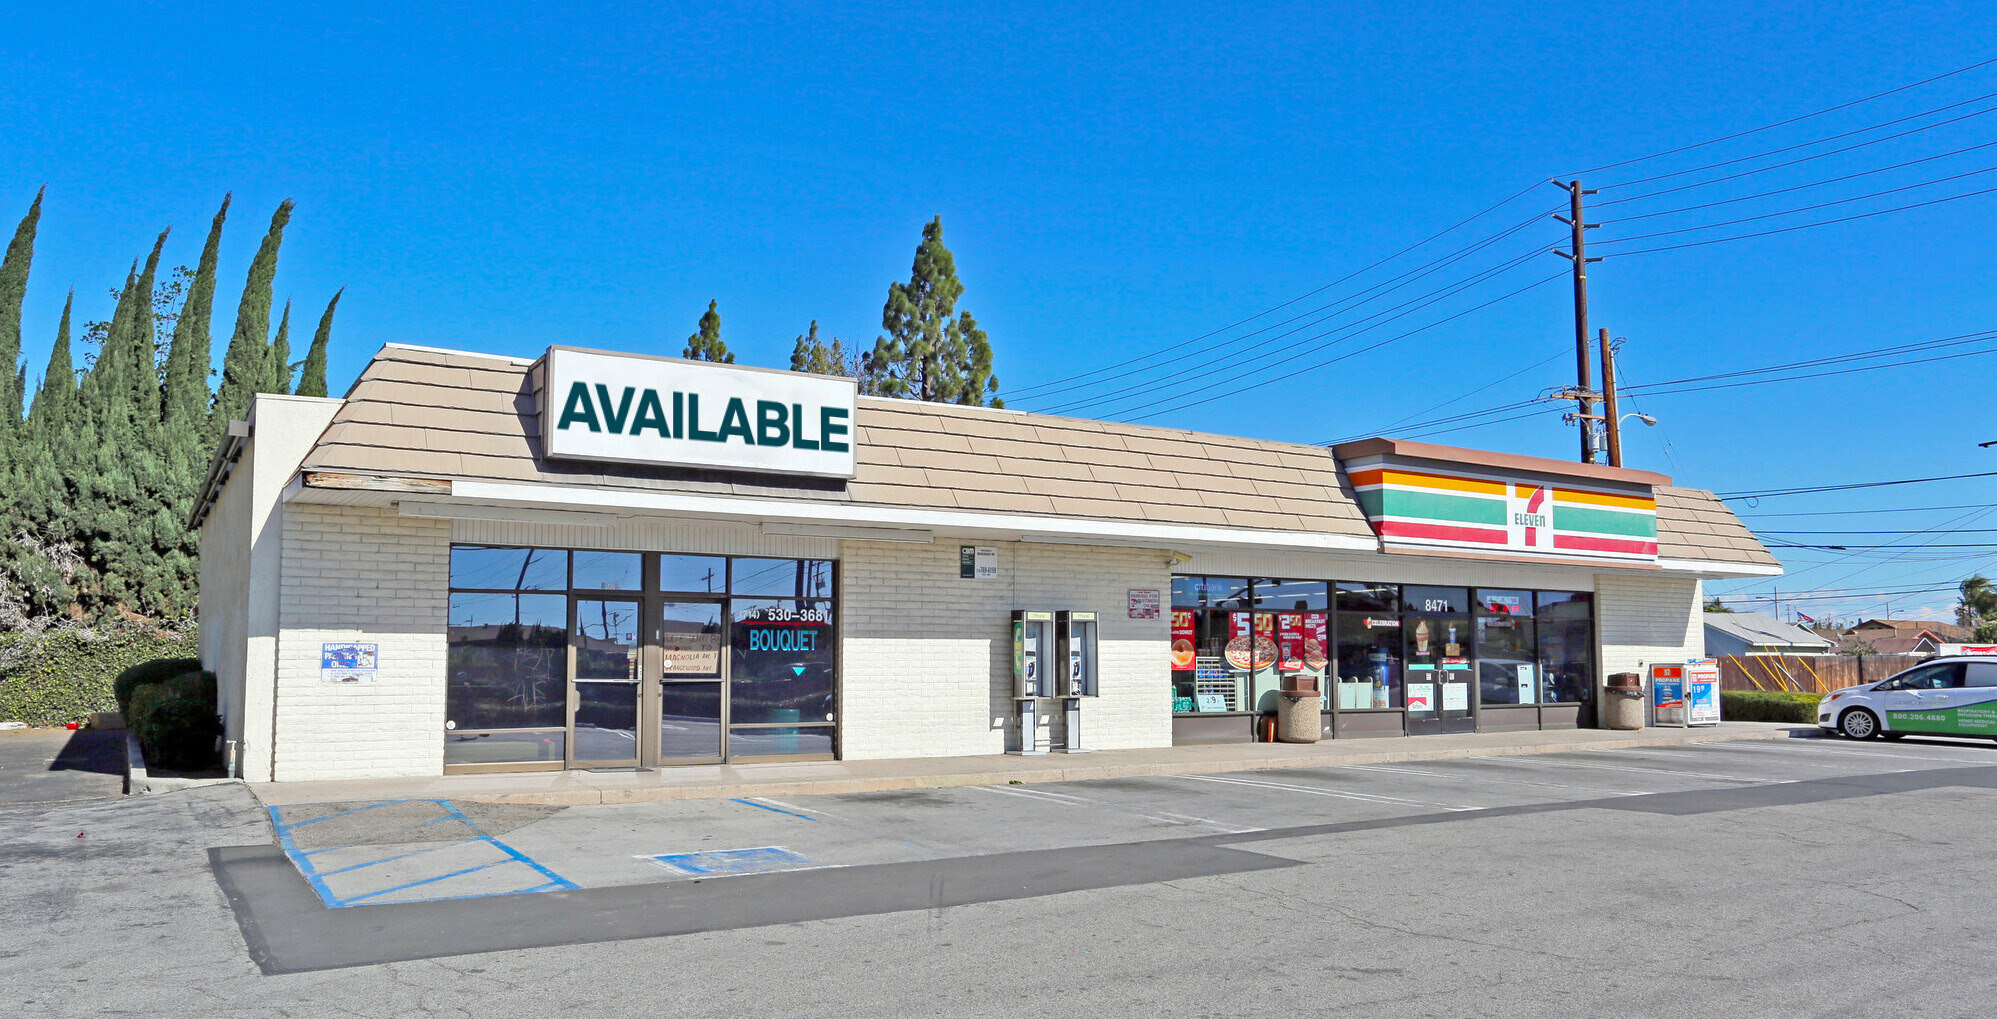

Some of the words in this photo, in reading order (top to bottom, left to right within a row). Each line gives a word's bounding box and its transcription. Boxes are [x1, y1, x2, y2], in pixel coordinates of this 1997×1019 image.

[557, 381, 849, 453] AVAILABLE
[1525, 485, 1544, 546] 7
[1425, 599, 1448, 612] 8471
[768, 609, 829, 621] 530-3681
[324, 644, 376, 652] HANDICAPPED
[750, 629, 818, 651] BOUQUET
